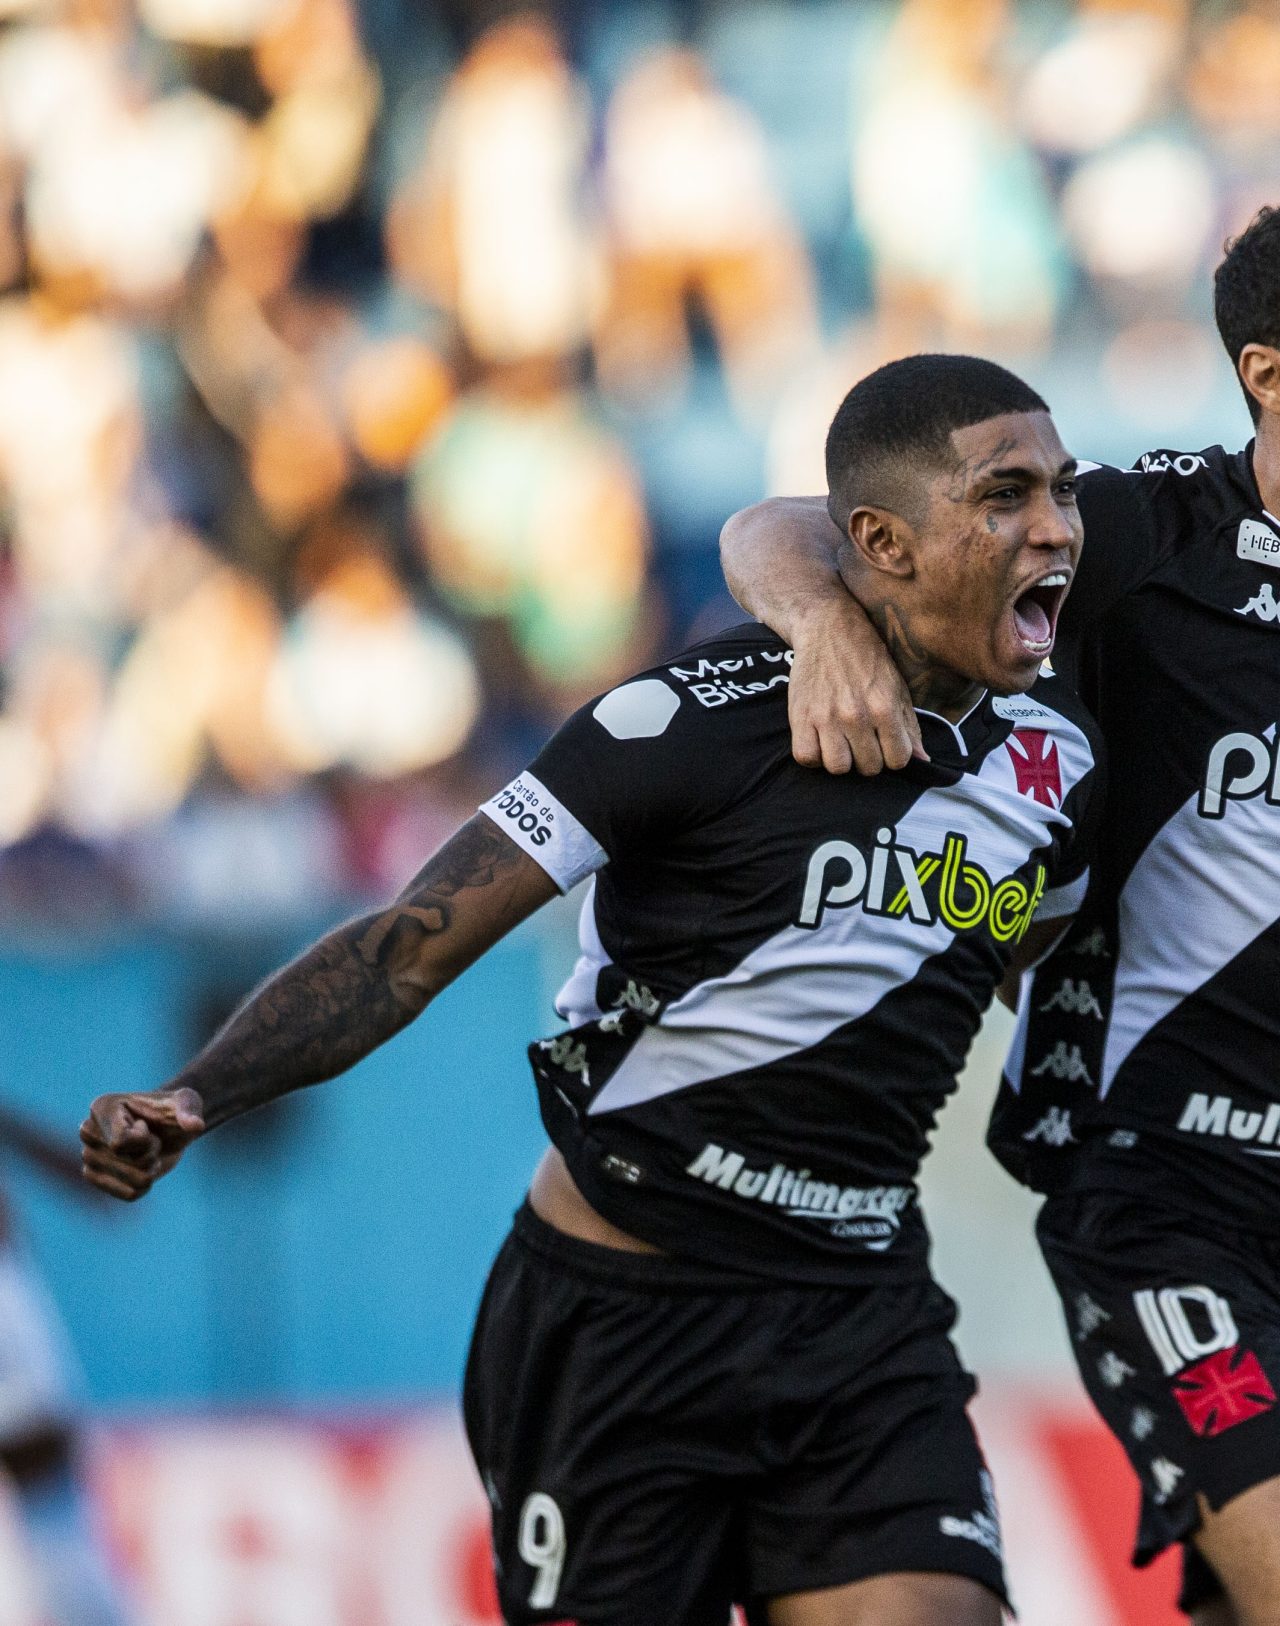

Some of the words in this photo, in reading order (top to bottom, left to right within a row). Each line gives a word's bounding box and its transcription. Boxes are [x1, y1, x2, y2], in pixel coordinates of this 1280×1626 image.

[1003, 709, 1051, 718] HEBRON
[492, 790, 552, 846] TODOS
[513, 780, 539, 807] Cartão
[539, 807, 554, 822] de
[1132, 1285, 1240, 1376] 10
[518, 1492, 566, 1608] 9
